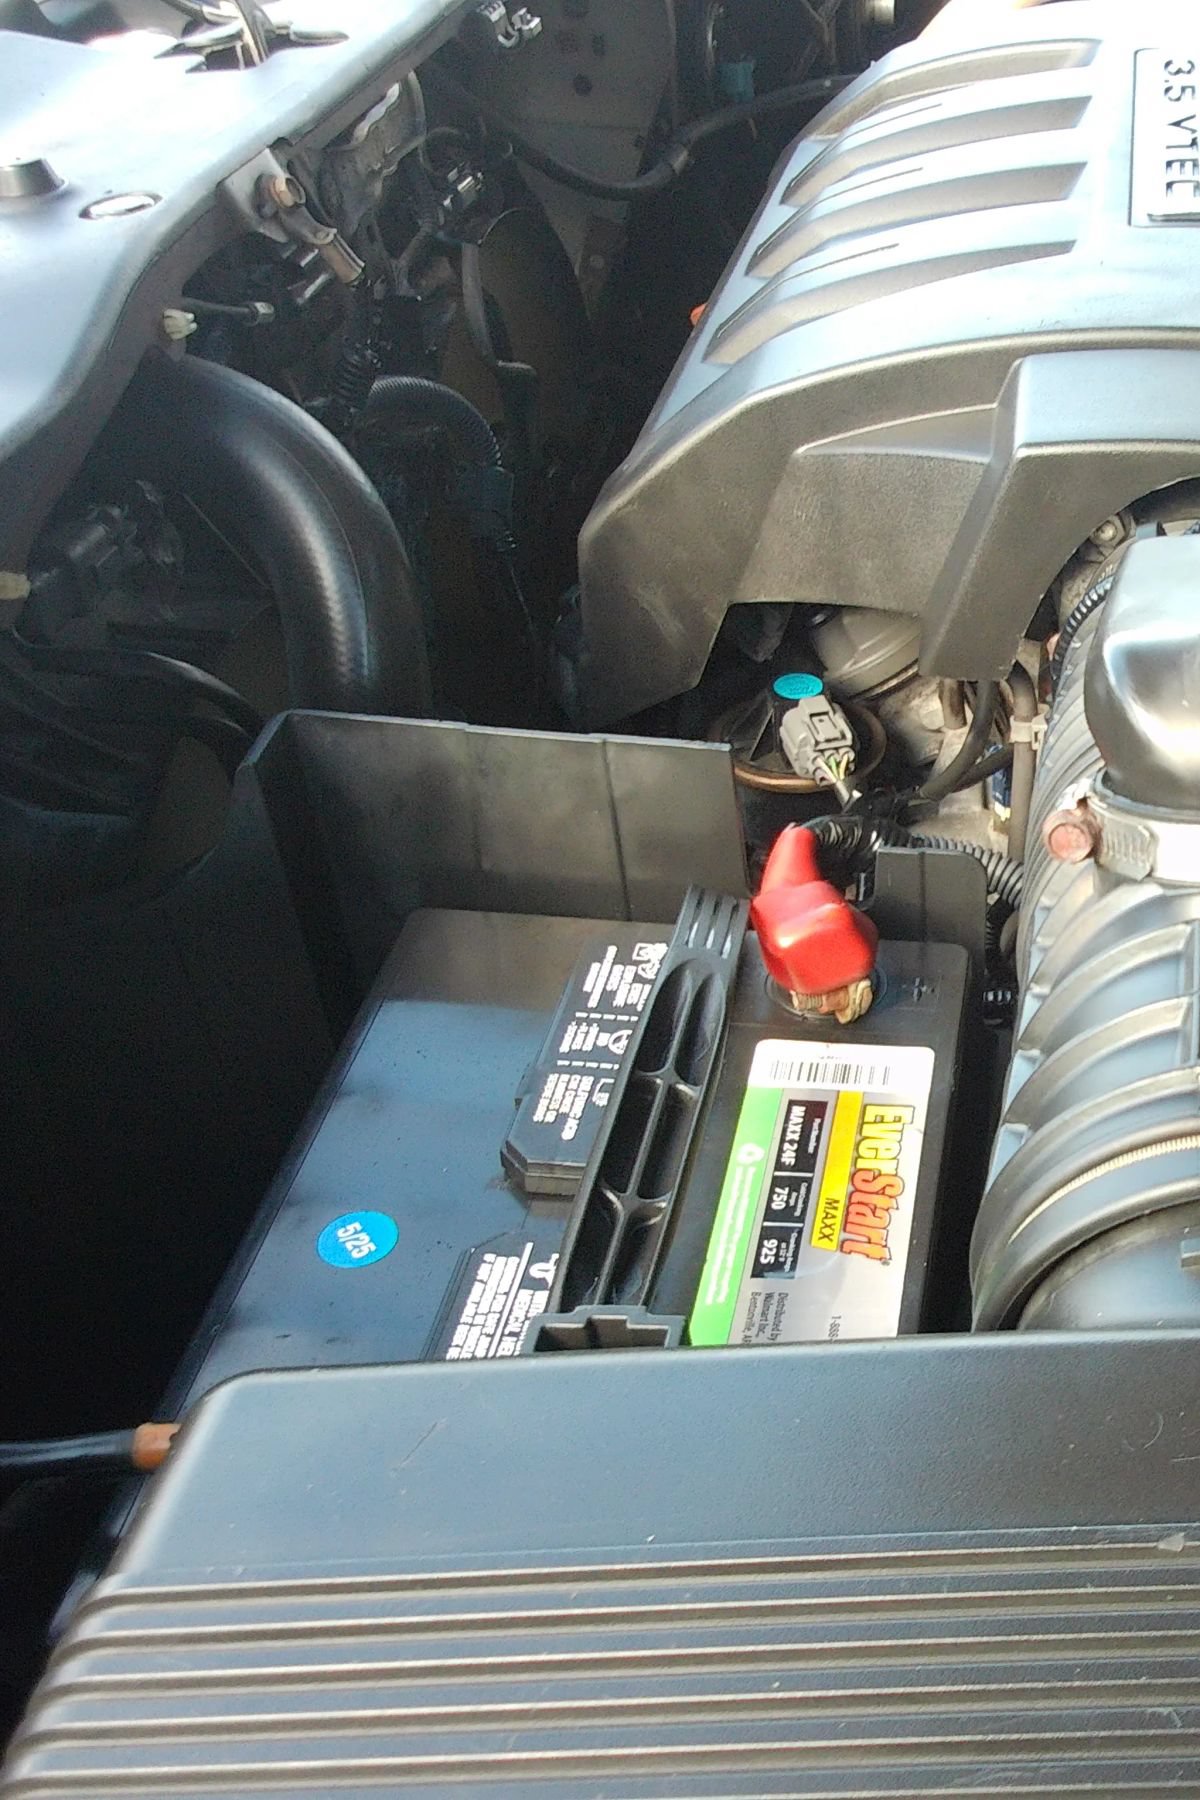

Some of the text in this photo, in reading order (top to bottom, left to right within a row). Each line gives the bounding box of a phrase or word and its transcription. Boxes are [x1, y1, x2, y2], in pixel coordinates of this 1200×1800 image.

[1164, 59, 1196, 102] 3.5
[782, 1105, 805, 1166] MAXX 24F
[772, 1187, 789, 1209] 750
[842, 1105, 914, 1261] EverStart
[336, 1222, 376, 1258] 5/25
[818, 1197, 840, 1243] MAXX
[761, 1239, 778, 1264] 925
[760, 1291, 776, 1322] Walmart
[766, 1291, 790, 1342] Distributed by
